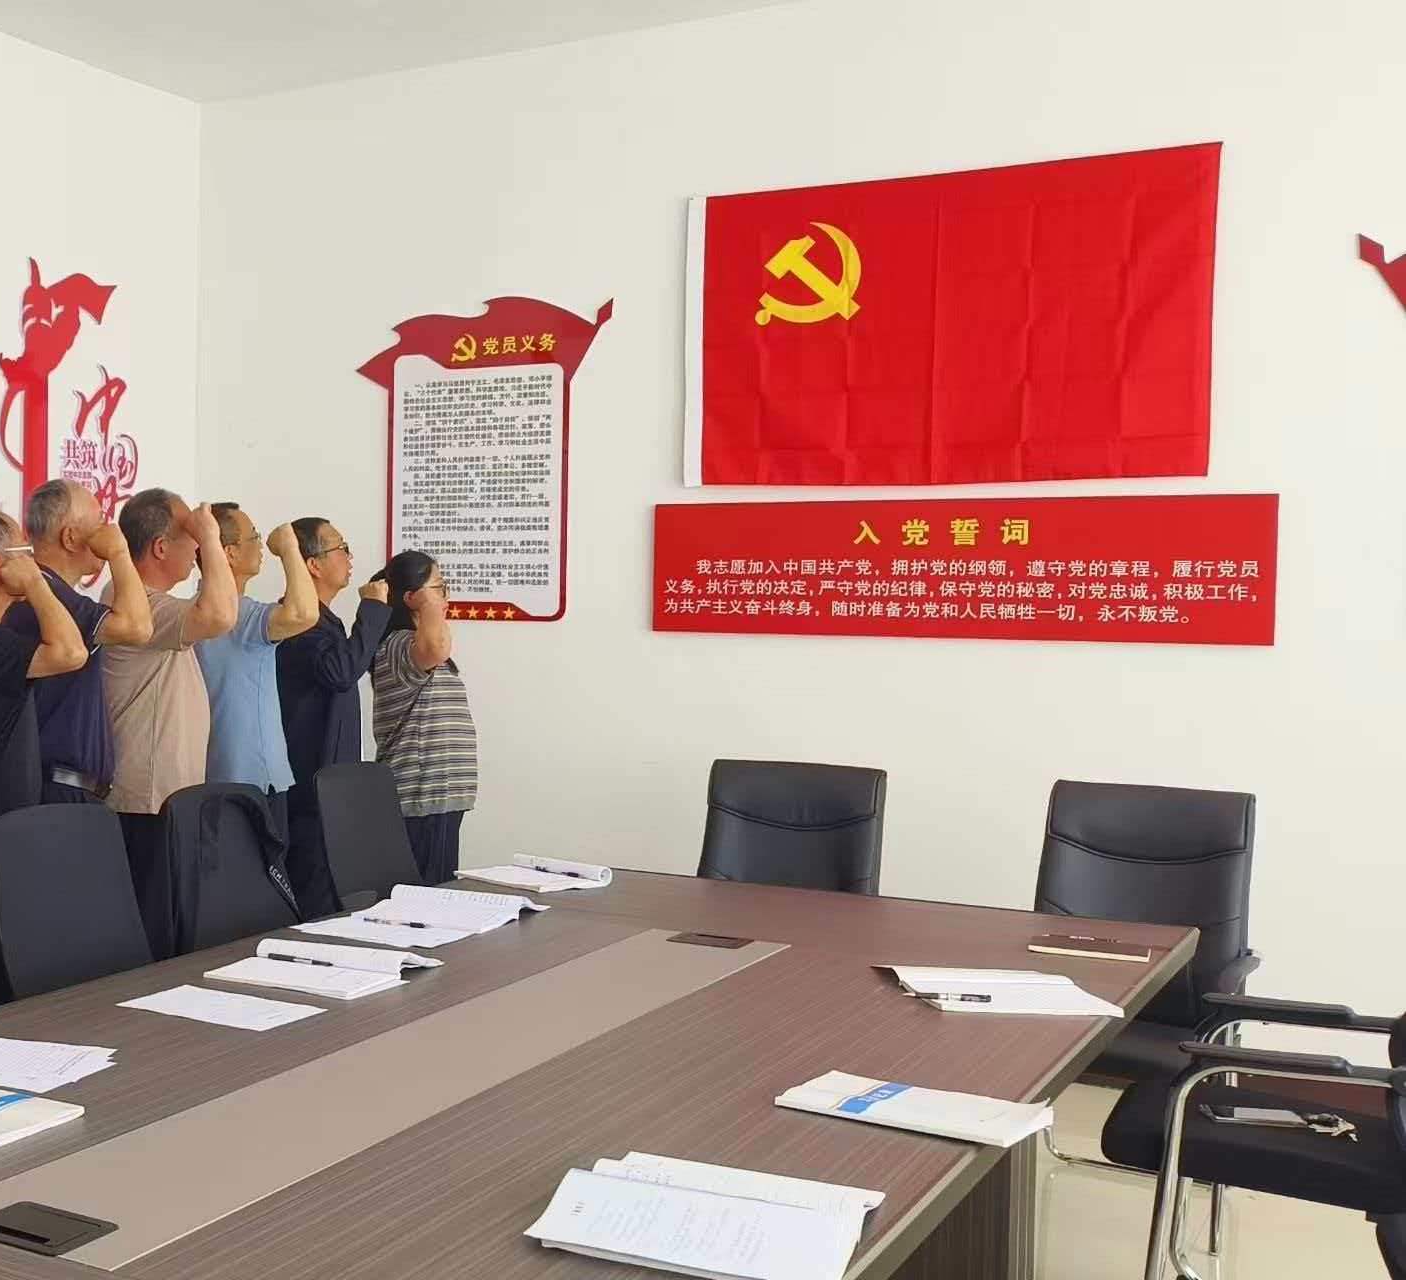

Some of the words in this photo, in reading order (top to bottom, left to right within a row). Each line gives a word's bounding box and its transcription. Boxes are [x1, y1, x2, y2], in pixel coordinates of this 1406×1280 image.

[483, 332, 557, 356] 党员义务
[64, 439, 98, 469] 共筑
[853, 518, 1031, 546] 入党誓词
[696, 557, 1261, 579] 我志愿加入中国共产党，拥护党的纲领，遵守党的章程，履行党员
[663, 578, 1259, 603] 义务，执行党的决定，严守党的纪律，保守党的秘密，对党忠诚，积极工作，
[663, 598, 1191, 625] 为共产主义奋斗终身，随时准备为党和人民牺牲一切，永不叛党。
